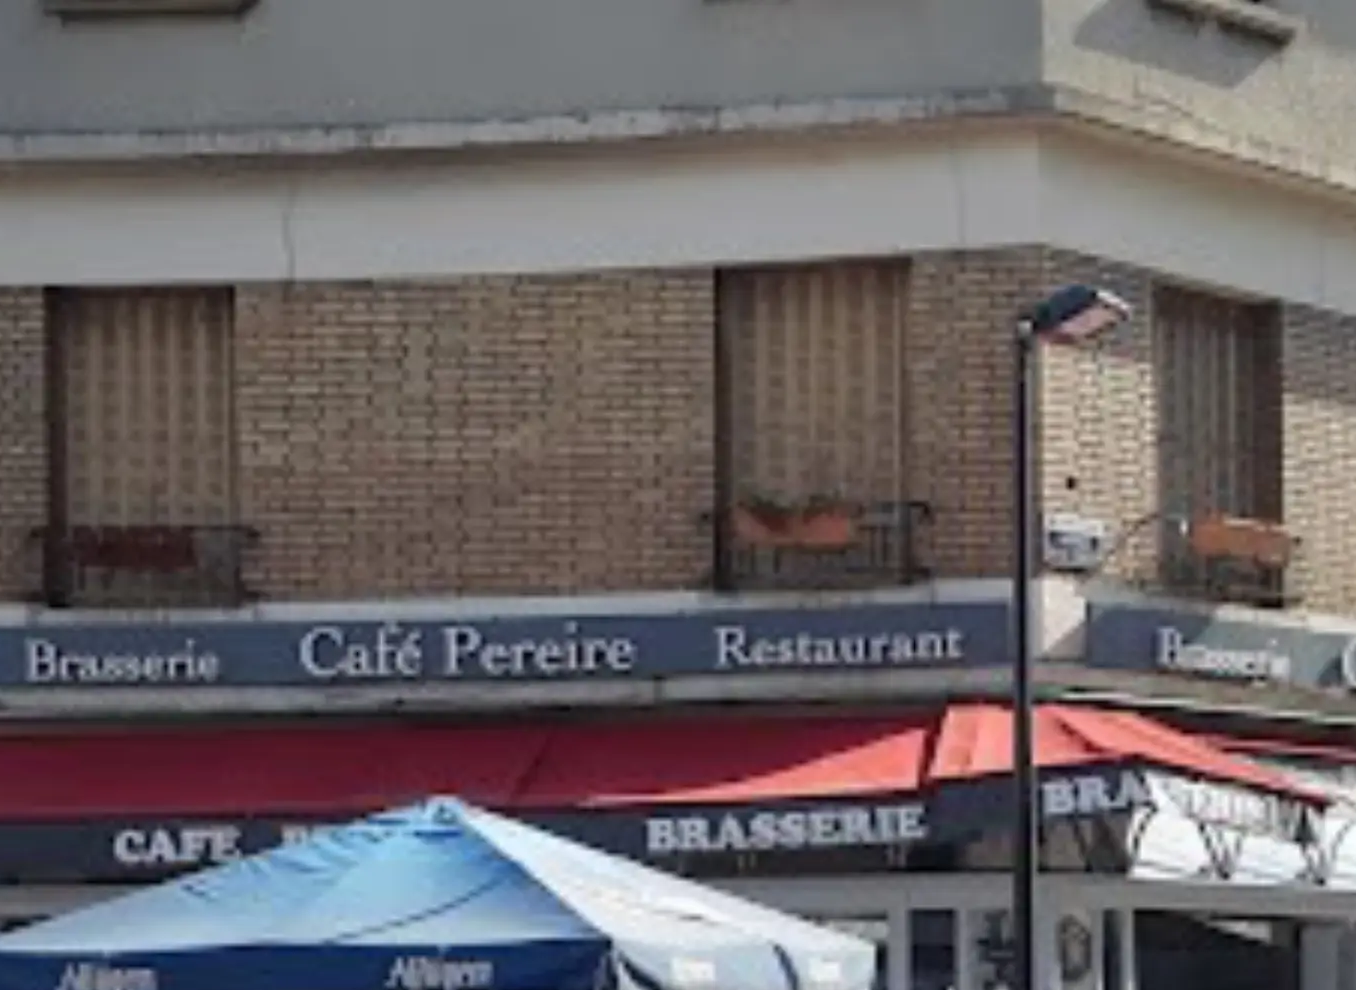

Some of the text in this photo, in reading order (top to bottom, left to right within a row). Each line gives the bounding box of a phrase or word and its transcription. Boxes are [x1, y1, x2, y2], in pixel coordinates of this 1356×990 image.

[25, 620, 966, 682] Brasserie Café Pereire Restaurant
[646, 804, 928, 852] BRASSERIE
